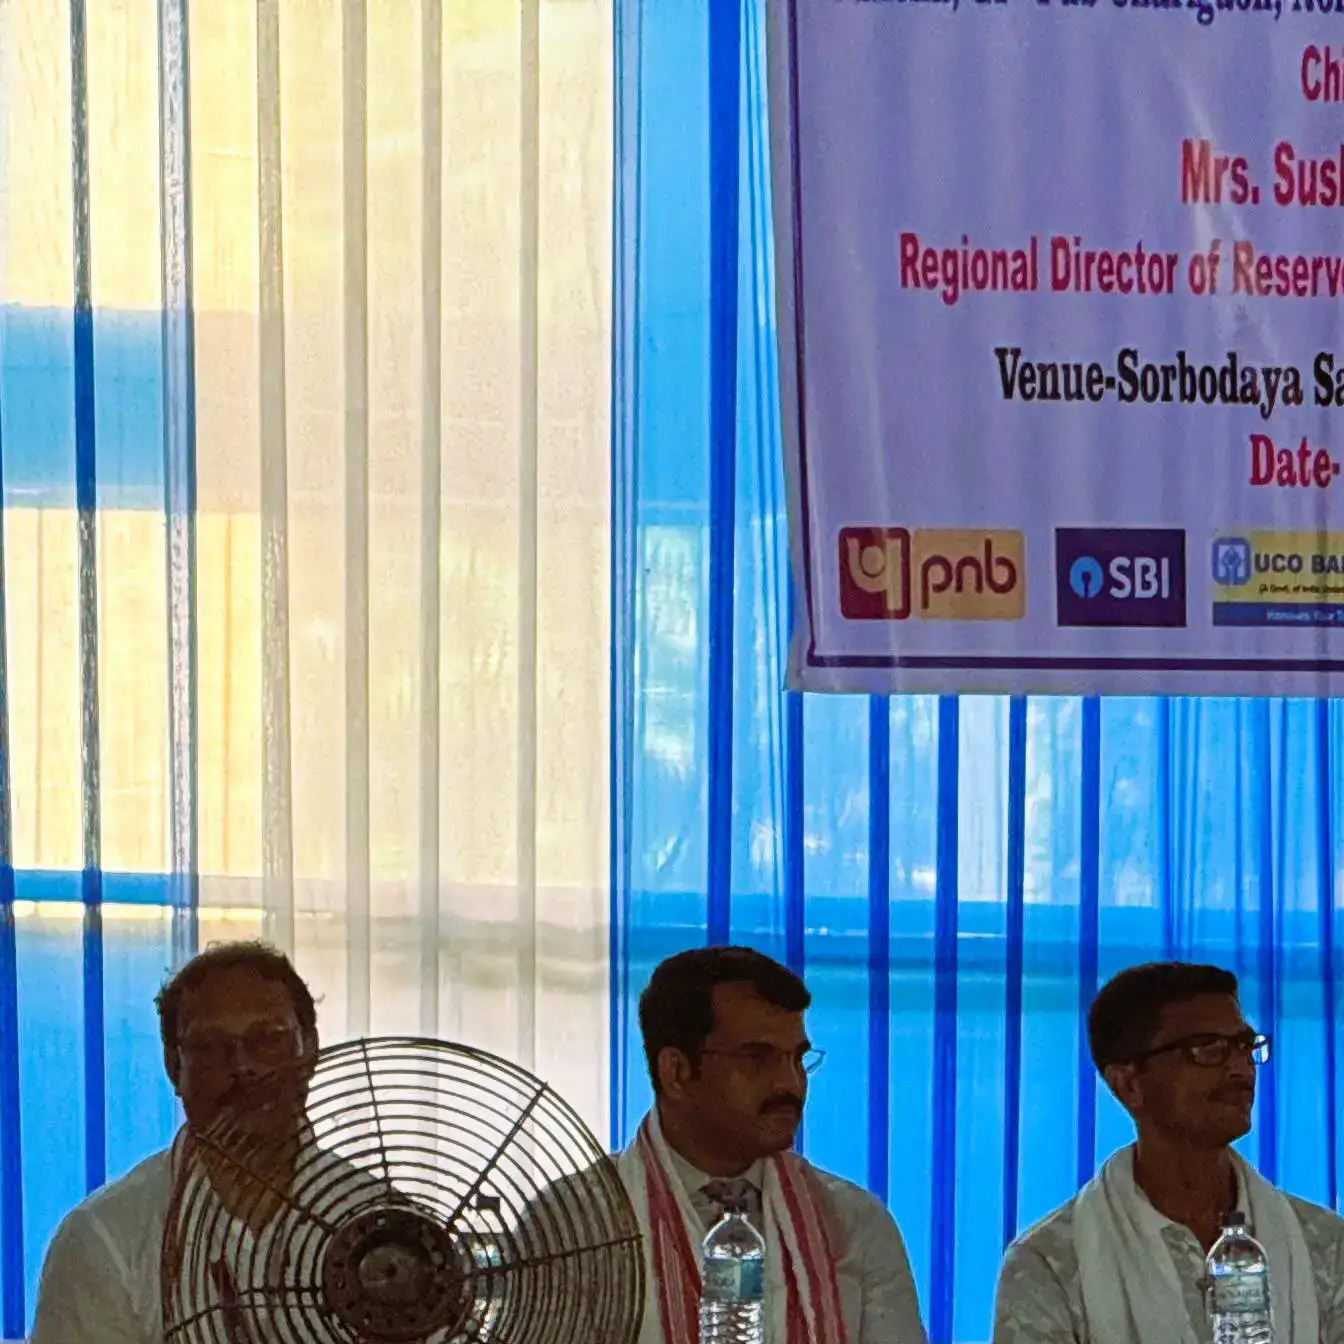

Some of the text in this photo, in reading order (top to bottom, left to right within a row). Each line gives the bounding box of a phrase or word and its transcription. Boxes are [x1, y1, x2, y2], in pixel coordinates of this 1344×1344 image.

[1181, 139, 1261, 206] Mrs.
[900, 233, 1038, 306] Regional
[1050, 236, 1179, 295] Director
[1188, 238, 1221, 296] of
[1249, 434, 1341, 488] Date-
[921, 538, 1018, 610] pnb
[1109, 556, 1170, 600] SBI
[1254, 553, 1304, 574] UCO
